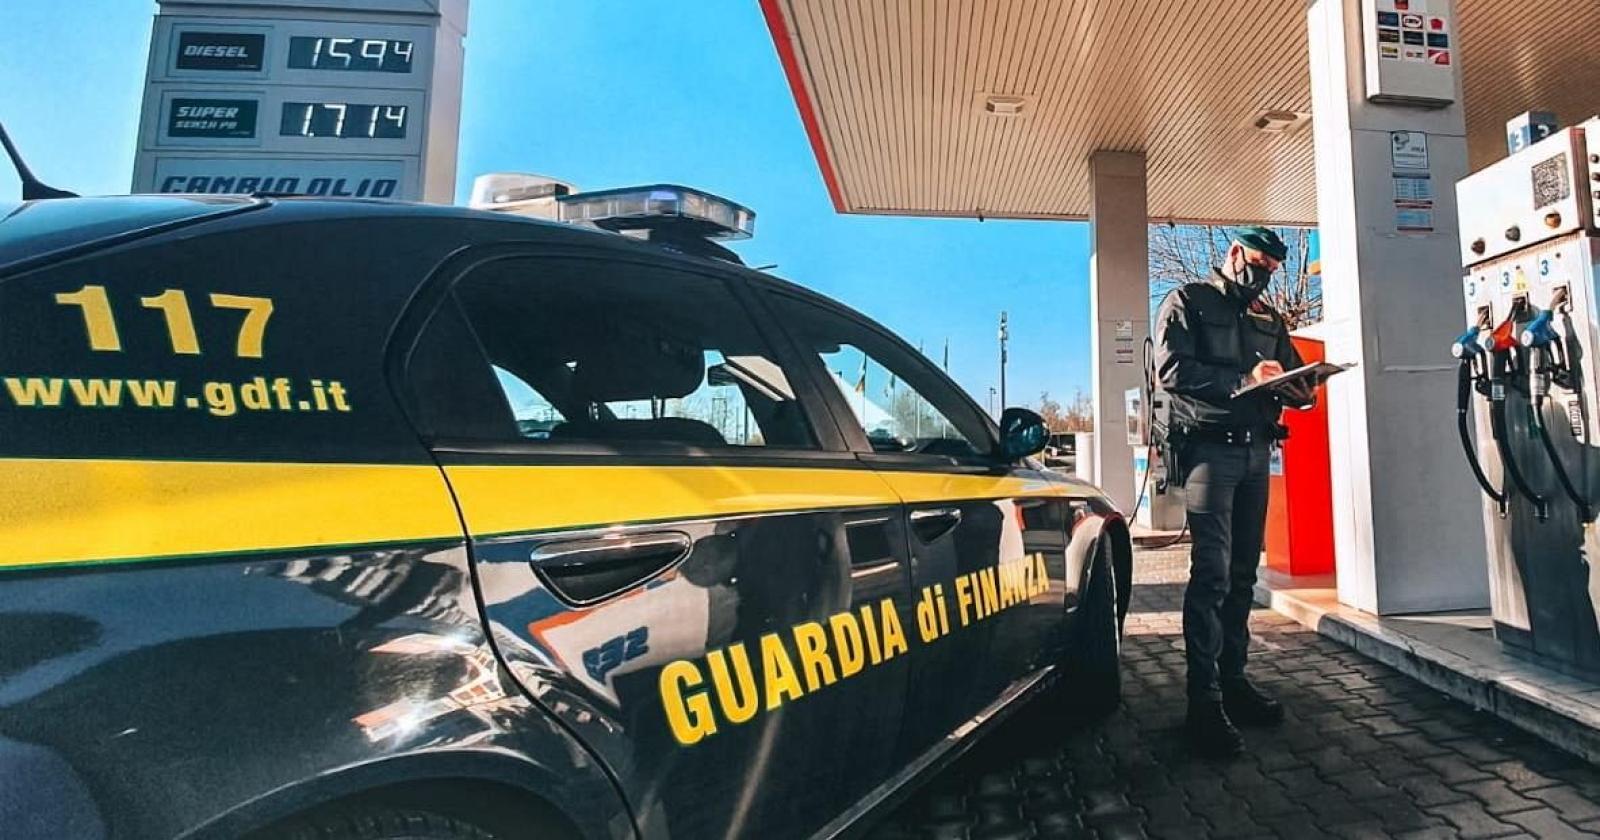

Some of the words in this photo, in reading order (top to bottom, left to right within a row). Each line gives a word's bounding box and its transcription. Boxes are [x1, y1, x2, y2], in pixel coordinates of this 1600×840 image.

[184, 45, 249, 58] DIESEL
[175, 106, 239, 118] SUPER
[160, 175, 299, 195] CAMBIO
[305, 177, 398, 198] OLIO
[1541, 259, 1549, 276] 3
[1503, 271, 1510, 287] 3
[55, 284, 274, 358] 117
[4, 376, 351, 416] www.gdf.it
[659, 598, 909, 747] GUARDIA
[916, 583, 950, 644] di
[955, 552, 1051, 627] FINANZA
